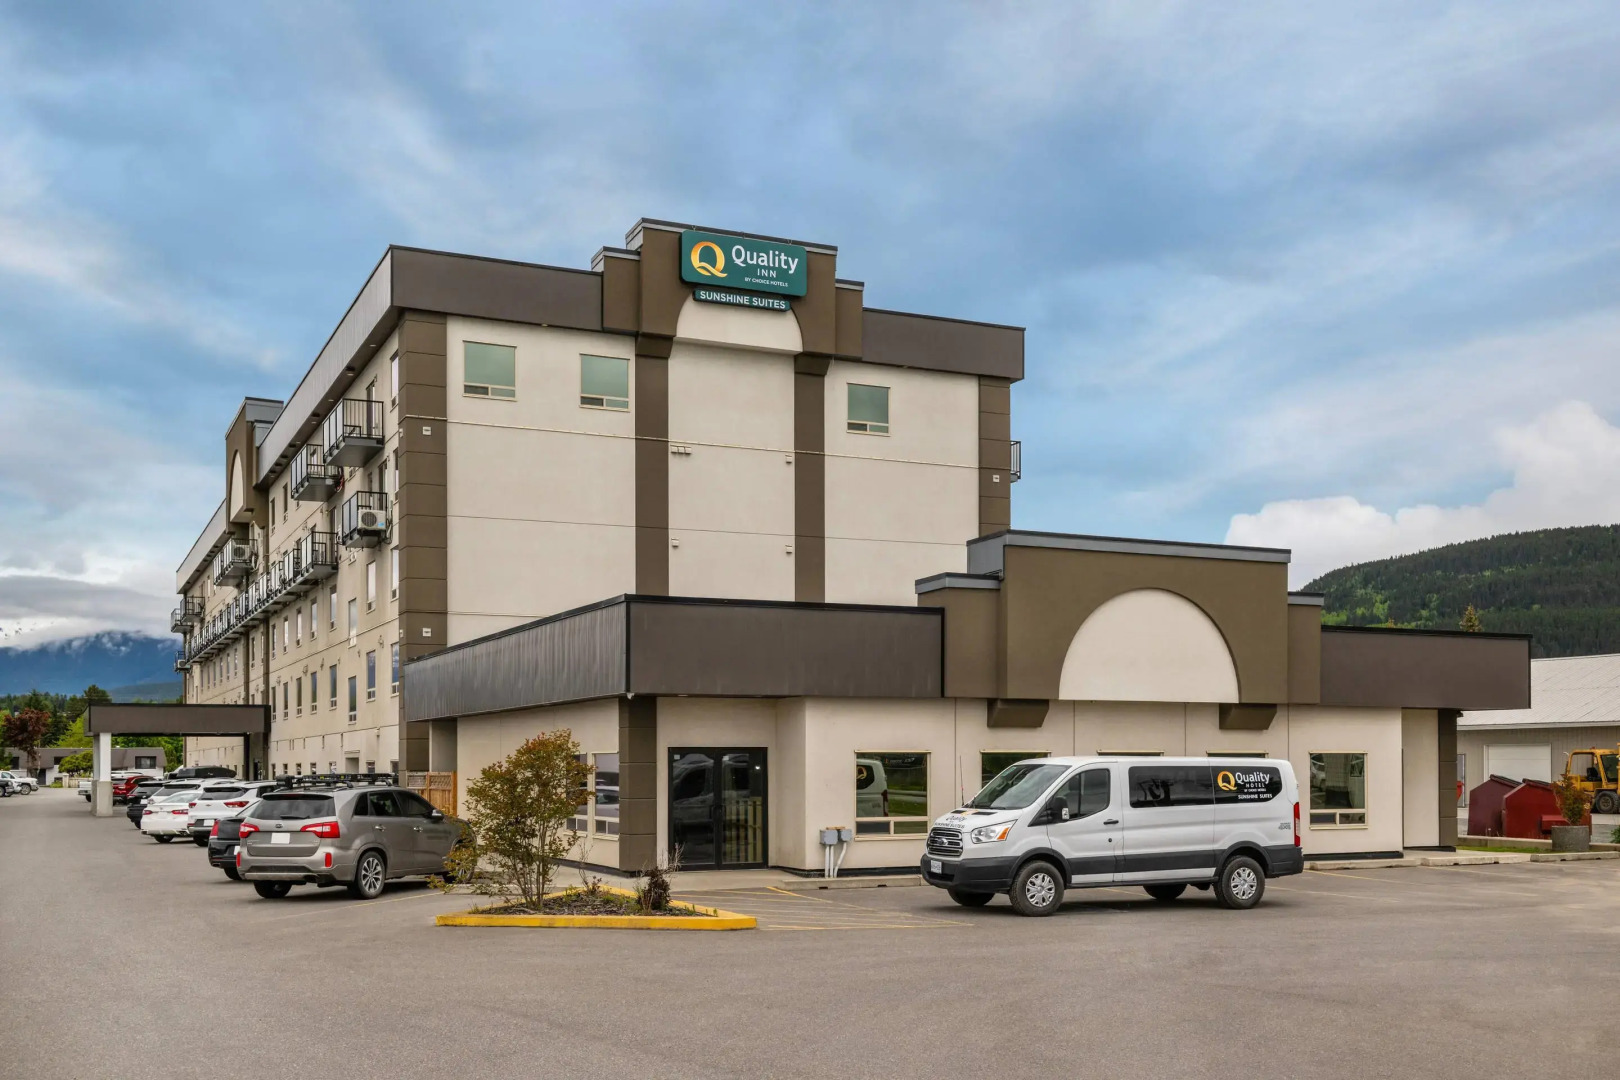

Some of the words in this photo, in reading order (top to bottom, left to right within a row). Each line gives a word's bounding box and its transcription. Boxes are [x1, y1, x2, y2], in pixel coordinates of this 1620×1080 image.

[731, 245, 799, 274] Quality
[757, 268, 777, 278] INN
[699, 290, 750, 305] SUNSHINE
[752, 297, 786, 309] SUITES
[1235, 771, 1270, 785] Quality
